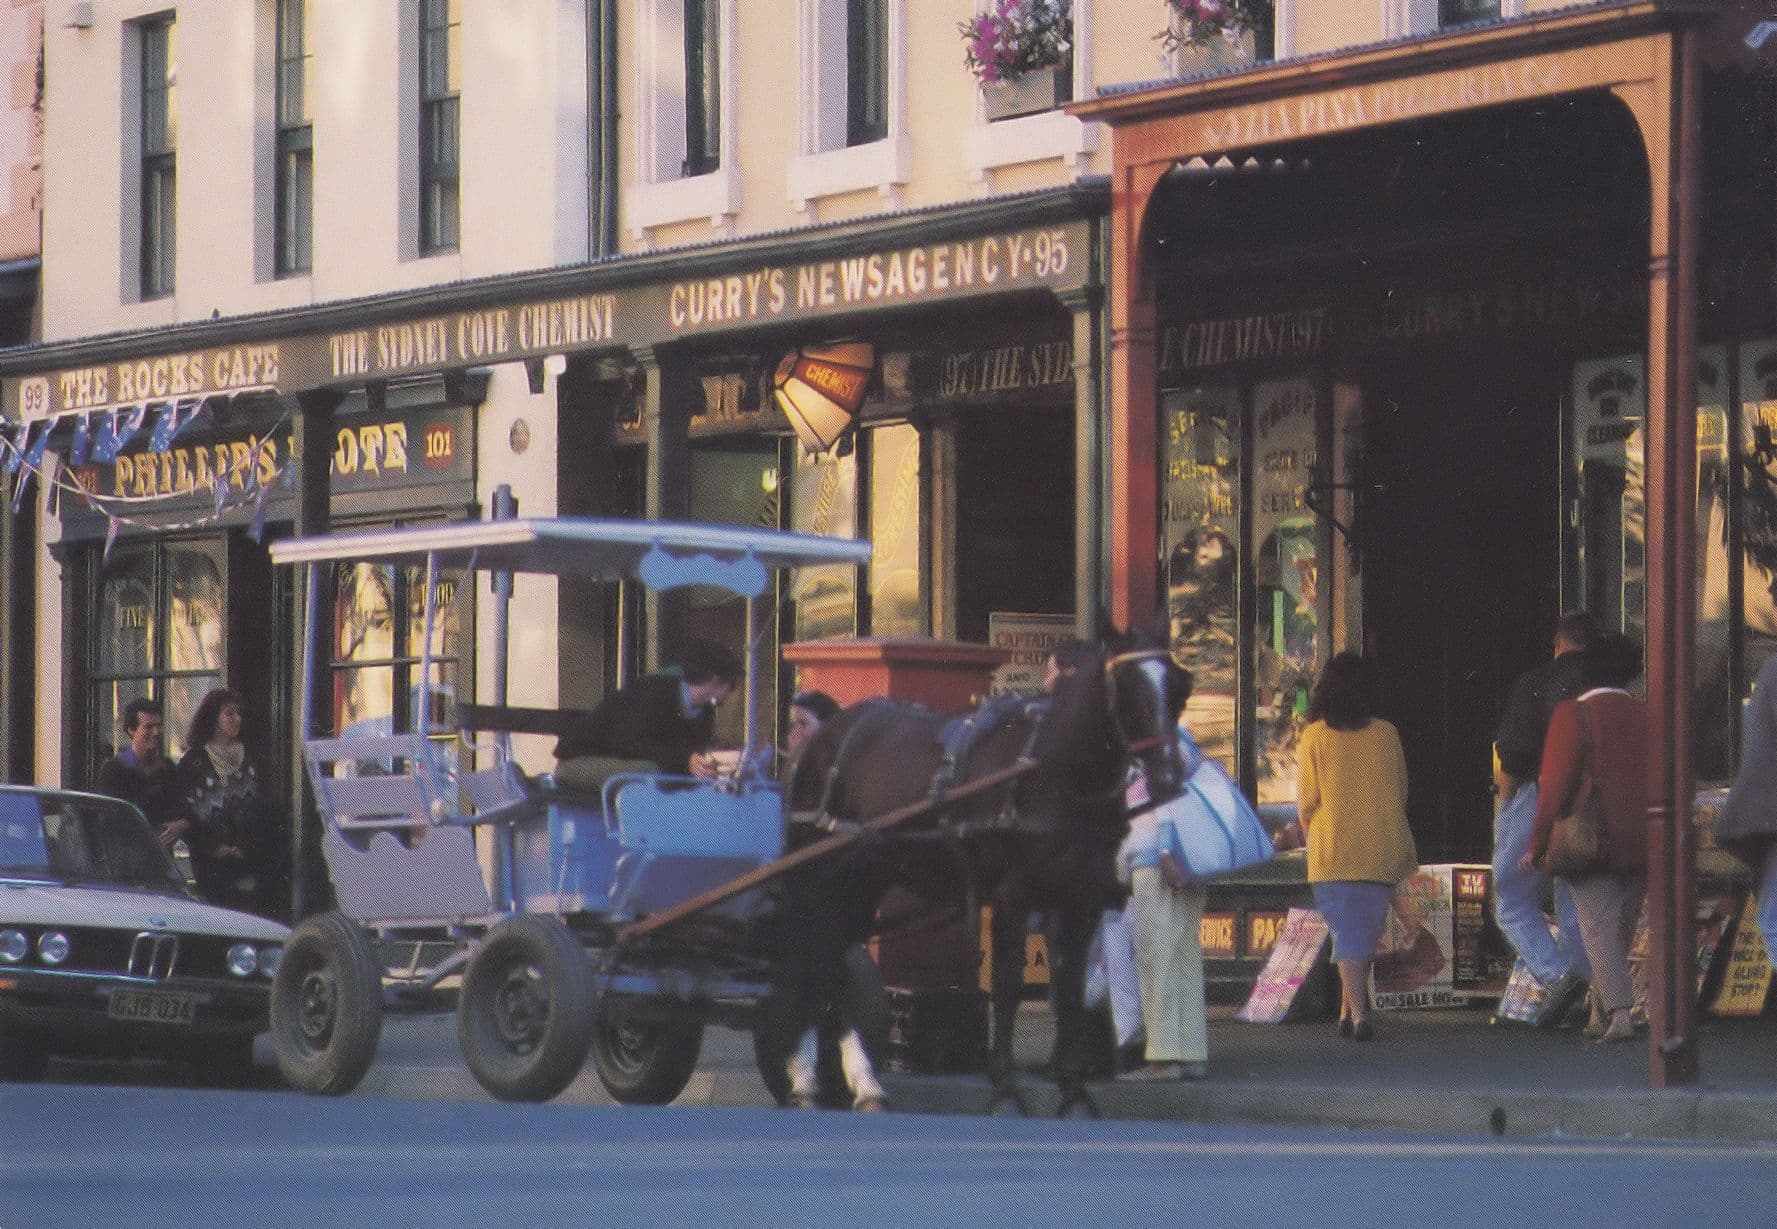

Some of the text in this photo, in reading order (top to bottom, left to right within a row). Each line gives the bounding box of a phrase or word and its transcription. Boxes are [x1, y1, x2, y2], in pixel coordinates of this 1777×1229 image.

[668, 265, 786, 328] CURRY'S
[330, 330, 370, 379] THE
[456, 308, 510, 361] COVE
[518, 295, 617, 352] CHEMIST
[23, 383, 43, 412] 99
[59, 344, 280, 409] THE ROCKS CAFE
[805, 362, 866, 401] CHEMIST
[114, 436, 278, 498] PHILLIP'S
[426, 431, 452, 458] 101
